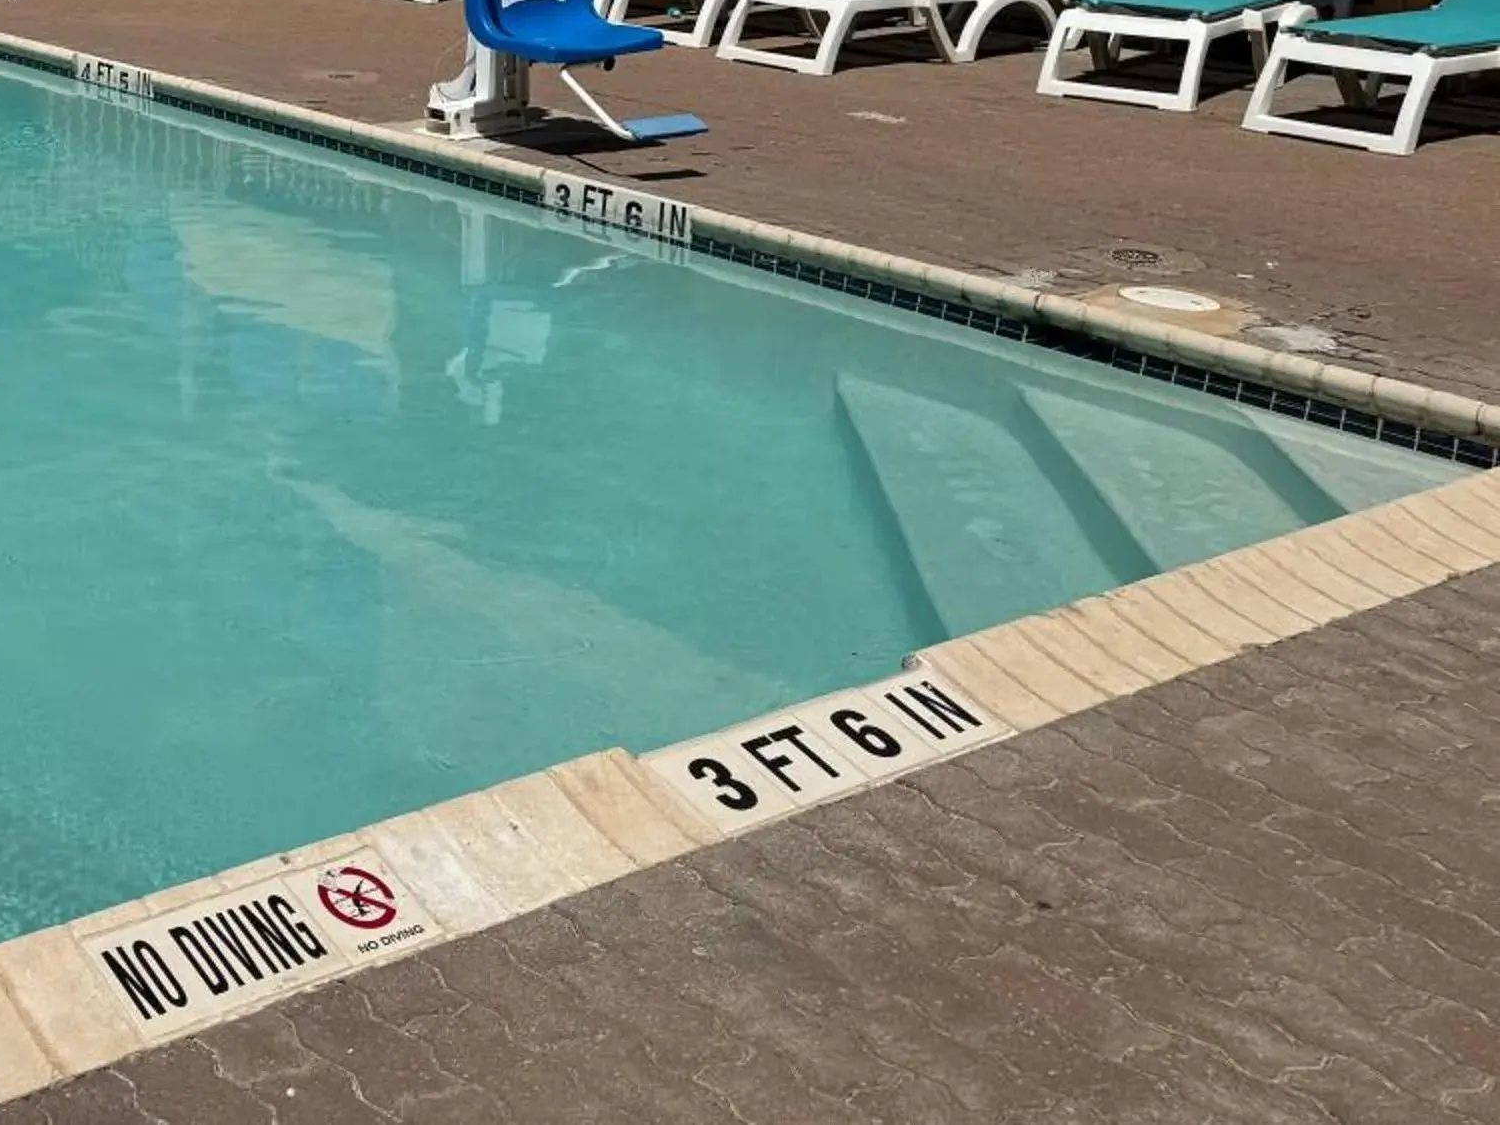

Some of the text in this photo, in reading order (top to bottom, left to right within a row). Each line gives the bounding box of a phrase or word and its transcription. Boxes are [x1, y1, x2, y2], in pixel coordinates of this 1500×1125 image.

[80, 61, 152, 95] 4 FT 5 IN
[554, 184, 688, 238] 3 FT 6 IN
[687, 680, 984, 812] 3 FT 6 IN
[100, 893, 329, 1021] NO DIVING
[357, 924, 425, 954] NO DIVING
